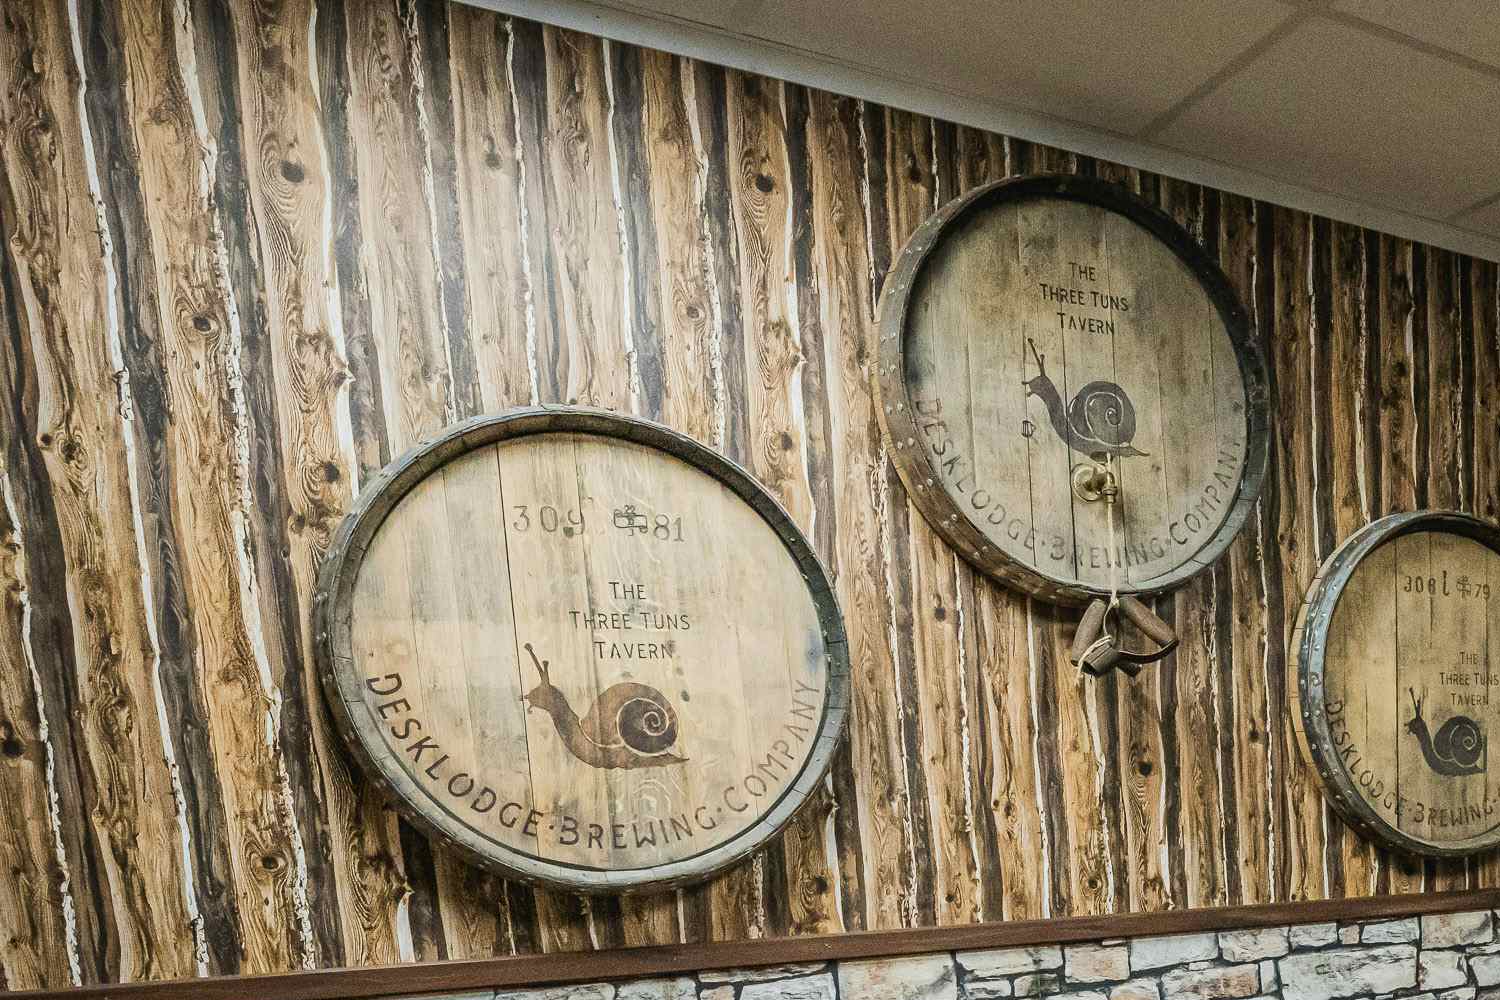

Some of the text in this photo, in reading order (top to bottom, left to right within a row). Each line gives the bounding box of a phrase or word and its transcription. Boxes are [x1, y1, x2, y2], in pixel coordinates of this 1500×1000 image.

[1068, 262, 1096, 281] THE
[1039, 283, 1129, 311] THREE TUNS
[1057, 312, 1115, 336] TAVERN
[608, 582, 647, 600] THE
[568, 611, 690, 630] THREE TUNS
[593, 641, 673, 659] TAVERN
[1459, 651, 1479, 664] THE
[1439, 672, 1499, 686] THREE TUNS
[1451, 693, 1489, 706] TAVERN
[365, 672, 821, 850] DESKLODGE BREWING COMPANY
